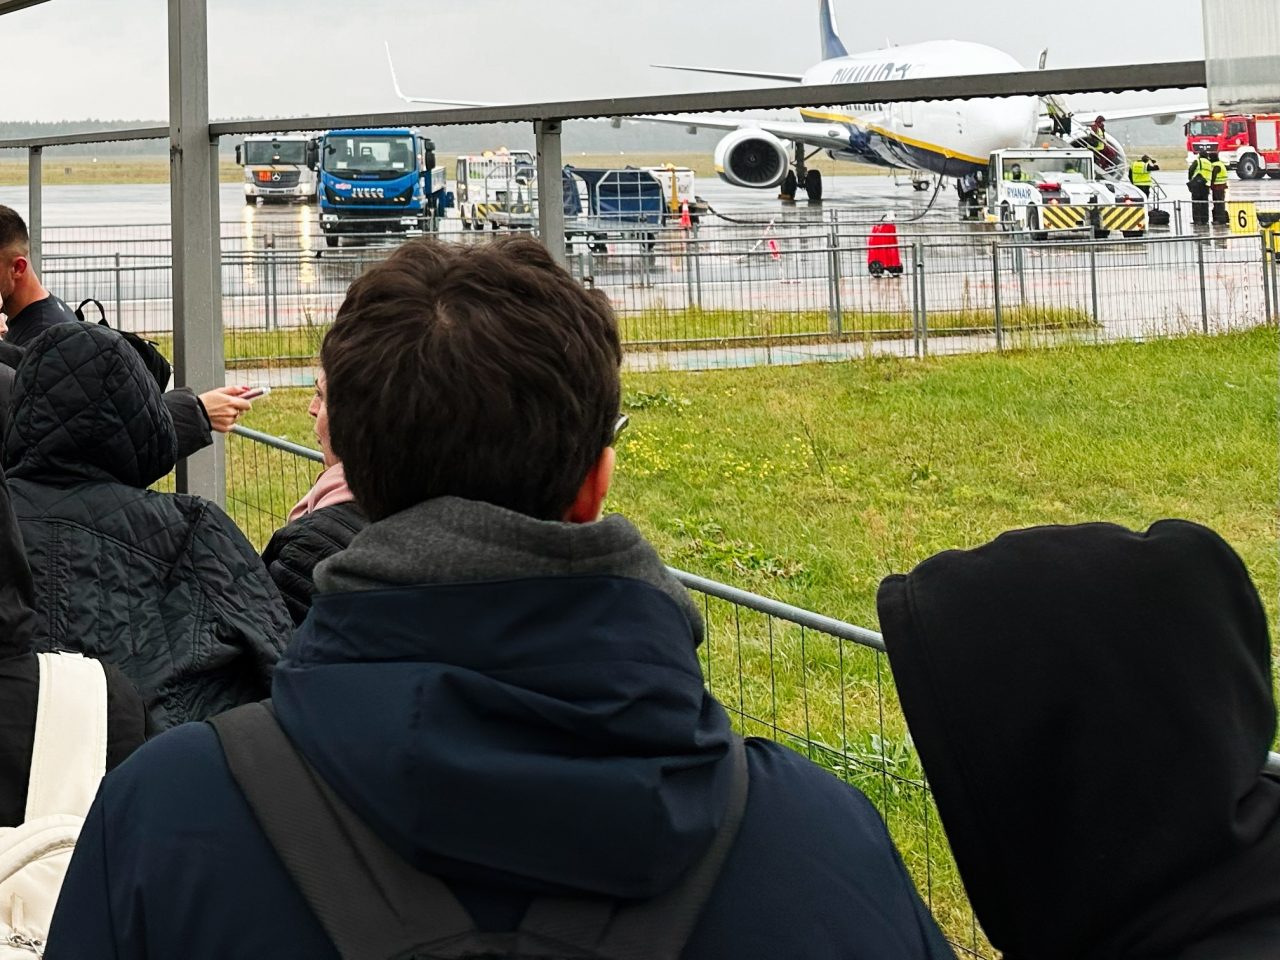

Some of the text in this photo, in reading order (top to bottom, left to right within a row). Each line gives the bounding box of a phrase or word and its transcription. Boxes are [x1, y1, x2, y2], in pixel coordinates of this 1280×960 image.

[351, 187, 385, 199] IVECO
[1007, 187, 1032, 199] RYANAIR
[1238, 210, 1247, 228] 6
